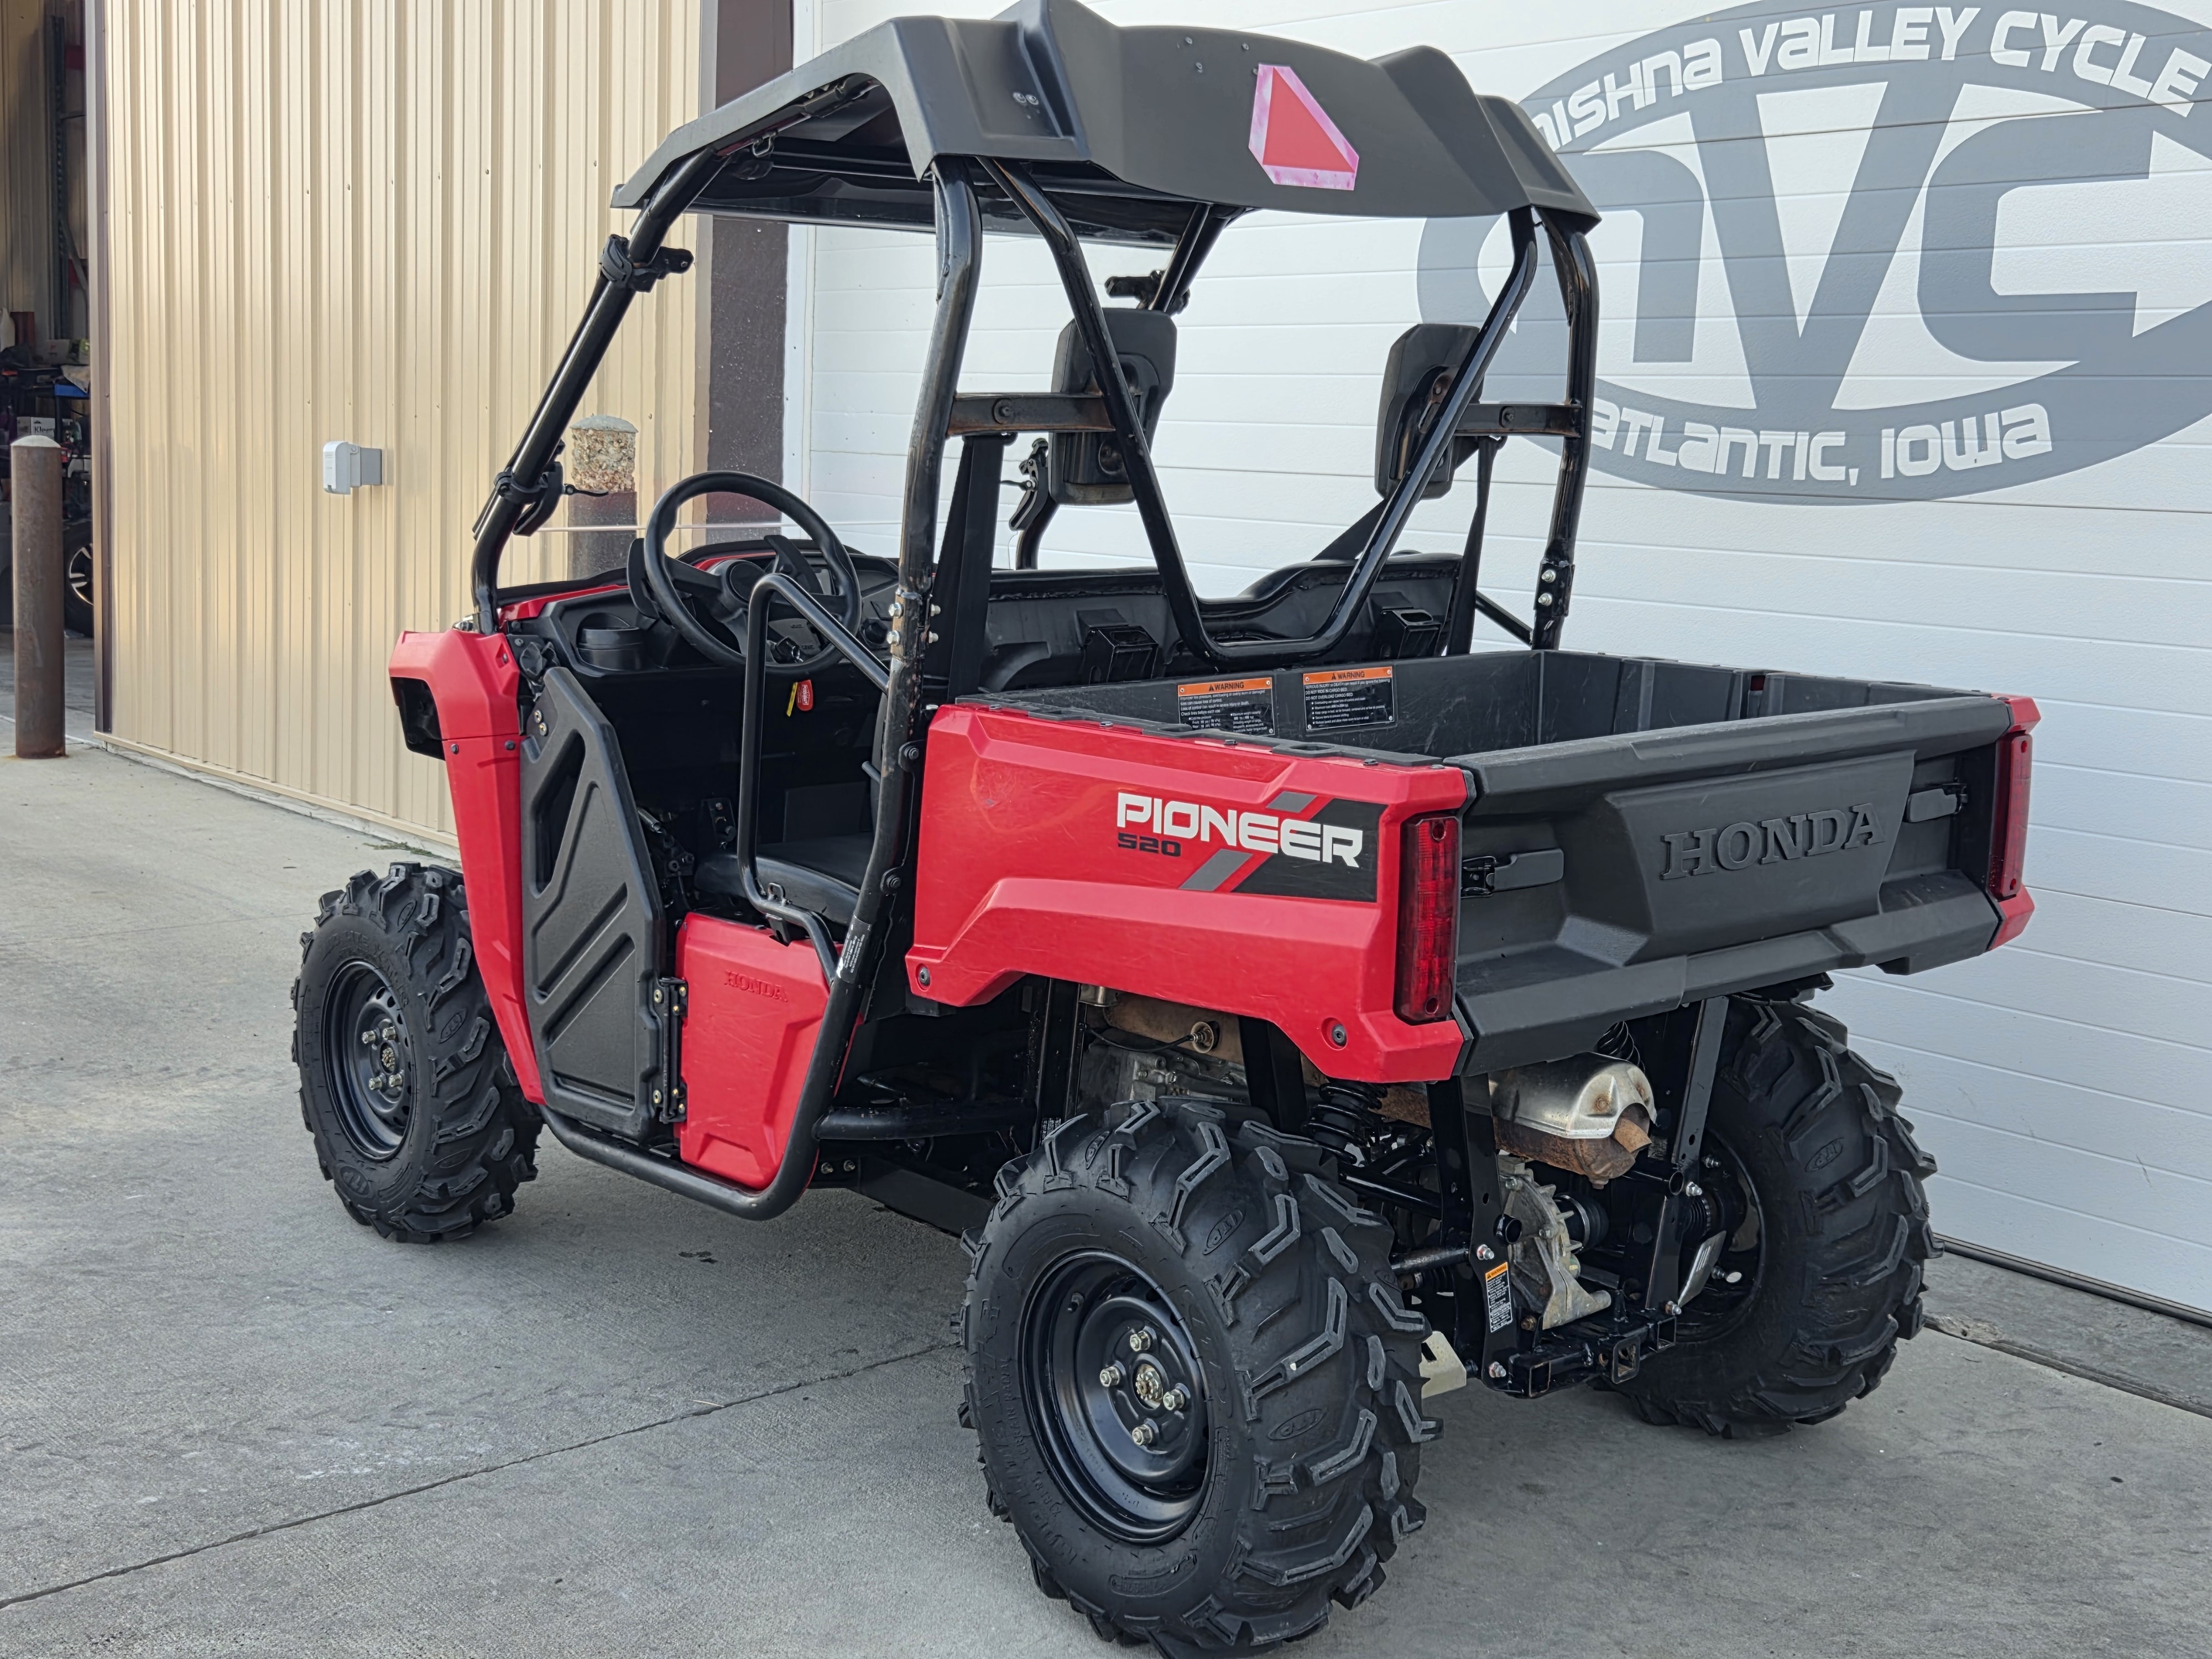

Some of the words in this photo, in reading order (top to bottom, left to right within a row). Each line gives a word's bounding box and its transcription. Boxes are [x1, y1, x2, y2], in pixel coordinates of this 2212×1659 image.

[1990, 11, 2212, 118] CYCLE
[1214, 682, 1244, 690] WARNING
[1337, 671, 1364, 679] WARNING
[1117, 792, 1363, 868] PIONEER
[1118, 832, 1181, 857] 520
[1660, 802, 1885, 880] HONDA
[723, 969, 788, 1003] HONDA
